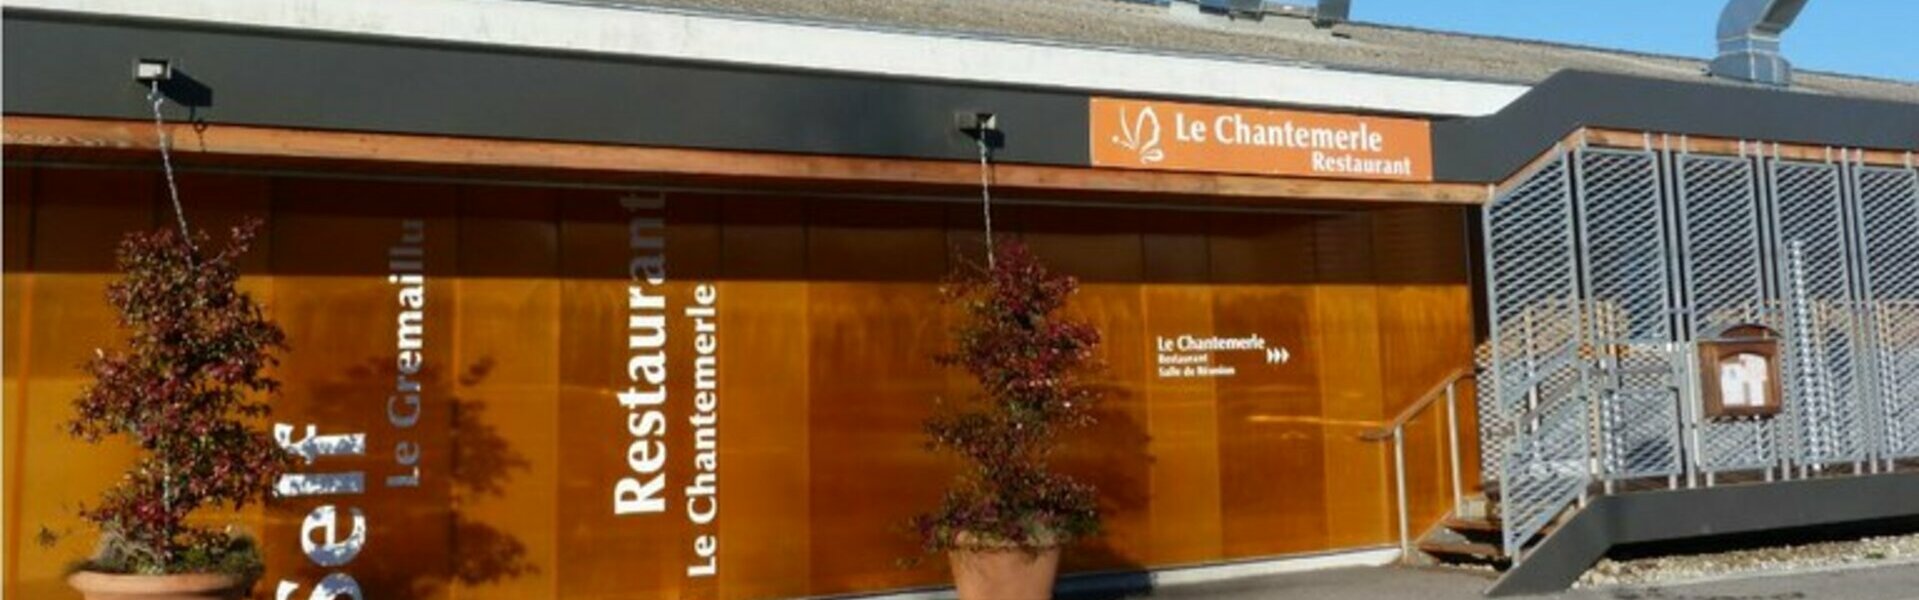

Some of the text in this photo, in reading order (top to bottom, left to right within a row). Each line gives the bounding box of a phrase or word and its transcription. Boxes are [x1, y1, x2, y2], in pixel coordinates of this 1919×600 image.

[1176, 113, 1382, 152] Le Chantemerle
[1311, 152, 1411, 176] Restaurant
[614, 191, 667, 515] Restaurant
[1157, 334, 1265, 351] Le Chantemerle
[685, 283, 717, 577] Le Chantemerle
[387, 441, 420, 487] Le
